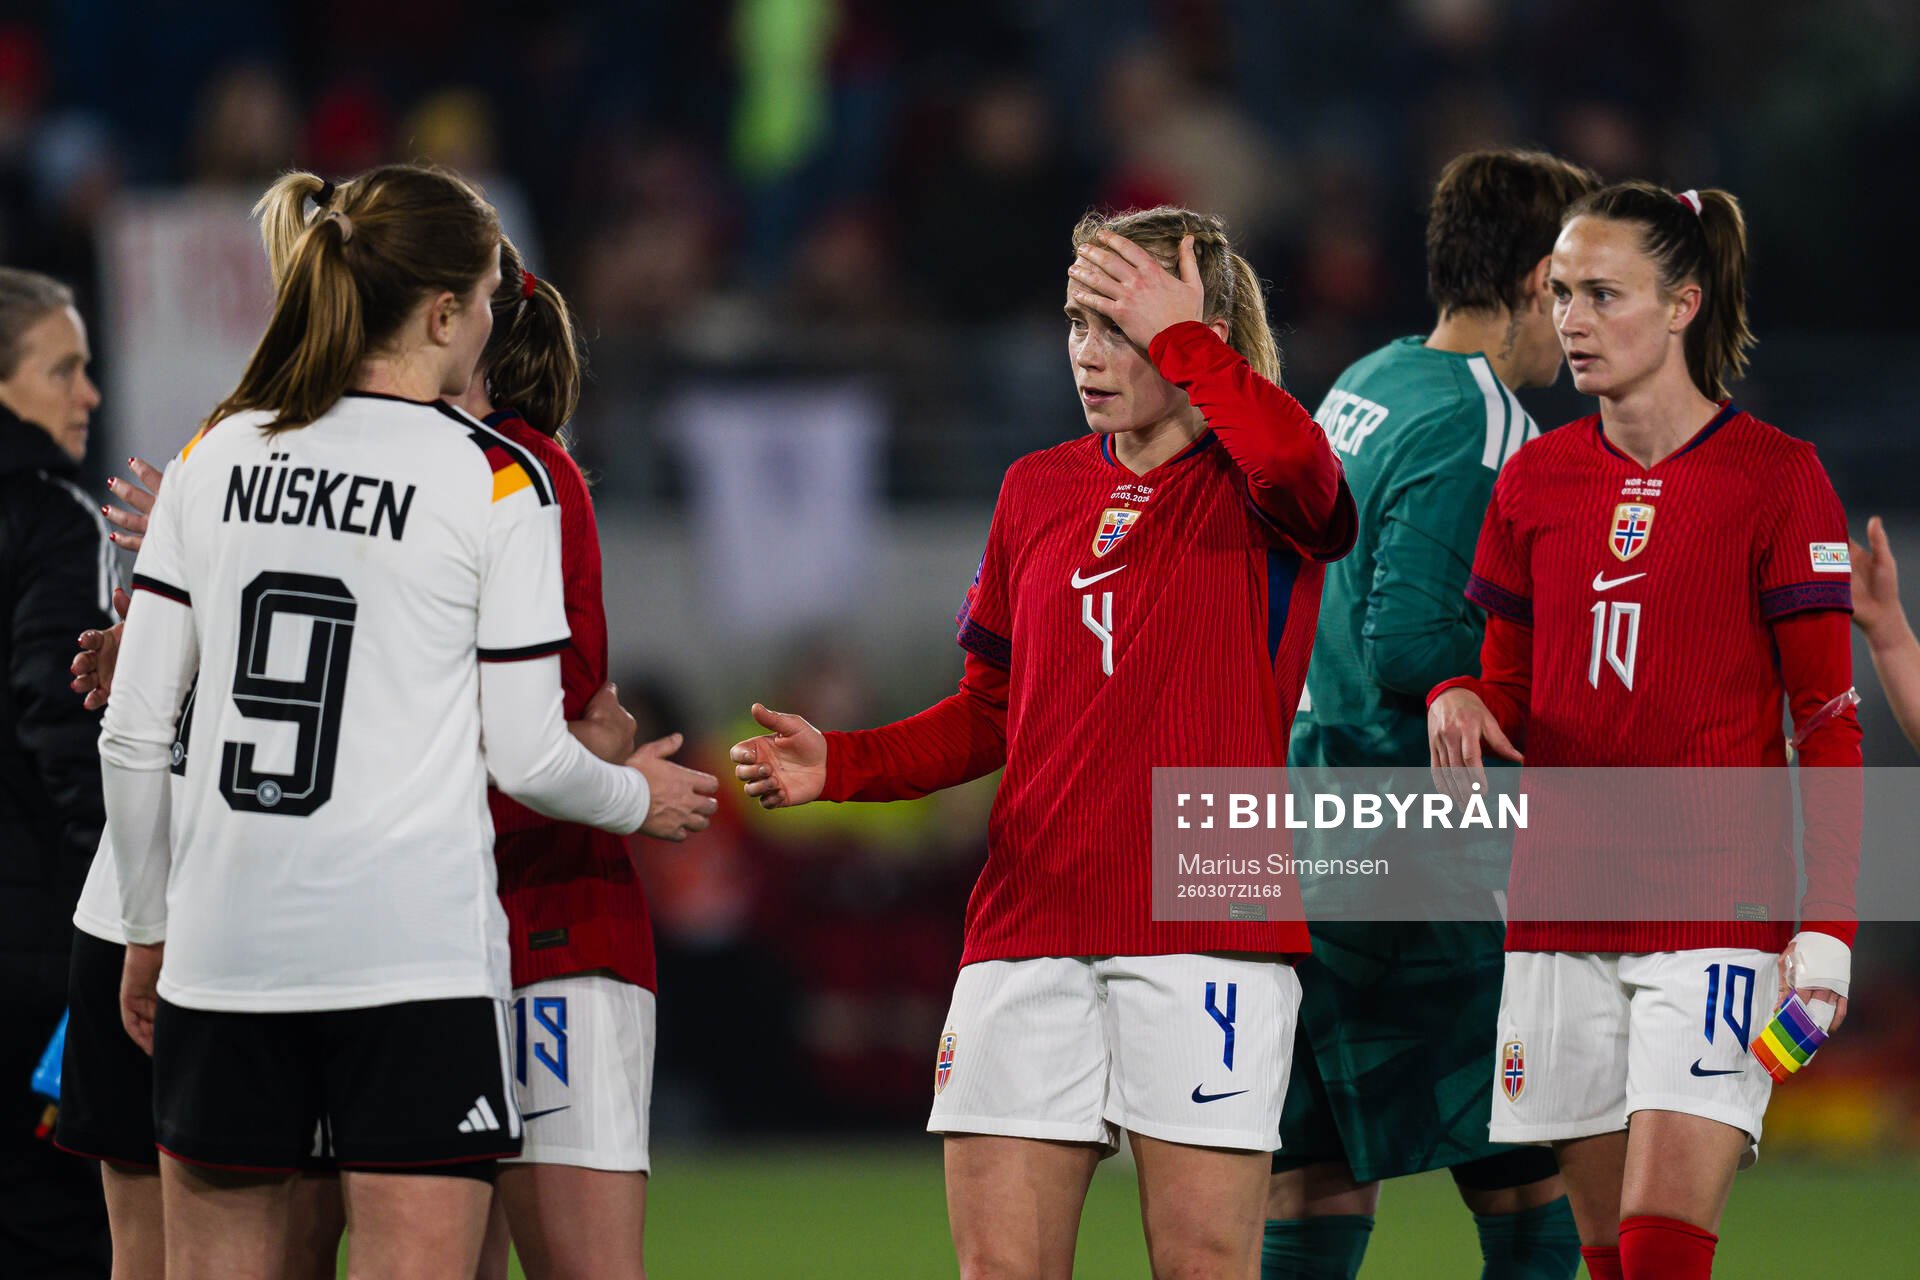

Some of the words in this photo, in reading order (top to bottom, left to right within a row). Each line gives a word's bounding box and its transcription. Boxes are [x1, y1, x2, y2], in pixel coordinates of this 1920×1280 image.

[223, 452, 416, 541] NÜSKEN
[1137, 485, 1154, 494] GER
[1082, 591, 1113, 677] 4
[1589, 601, 1642, 692] 10
[219, 570, 358, 817] 9
[512, 997, 569, 1087] 19
[1204, 981, 1237, 1072] 4
[1704, 963, 1756, 1054] 10
